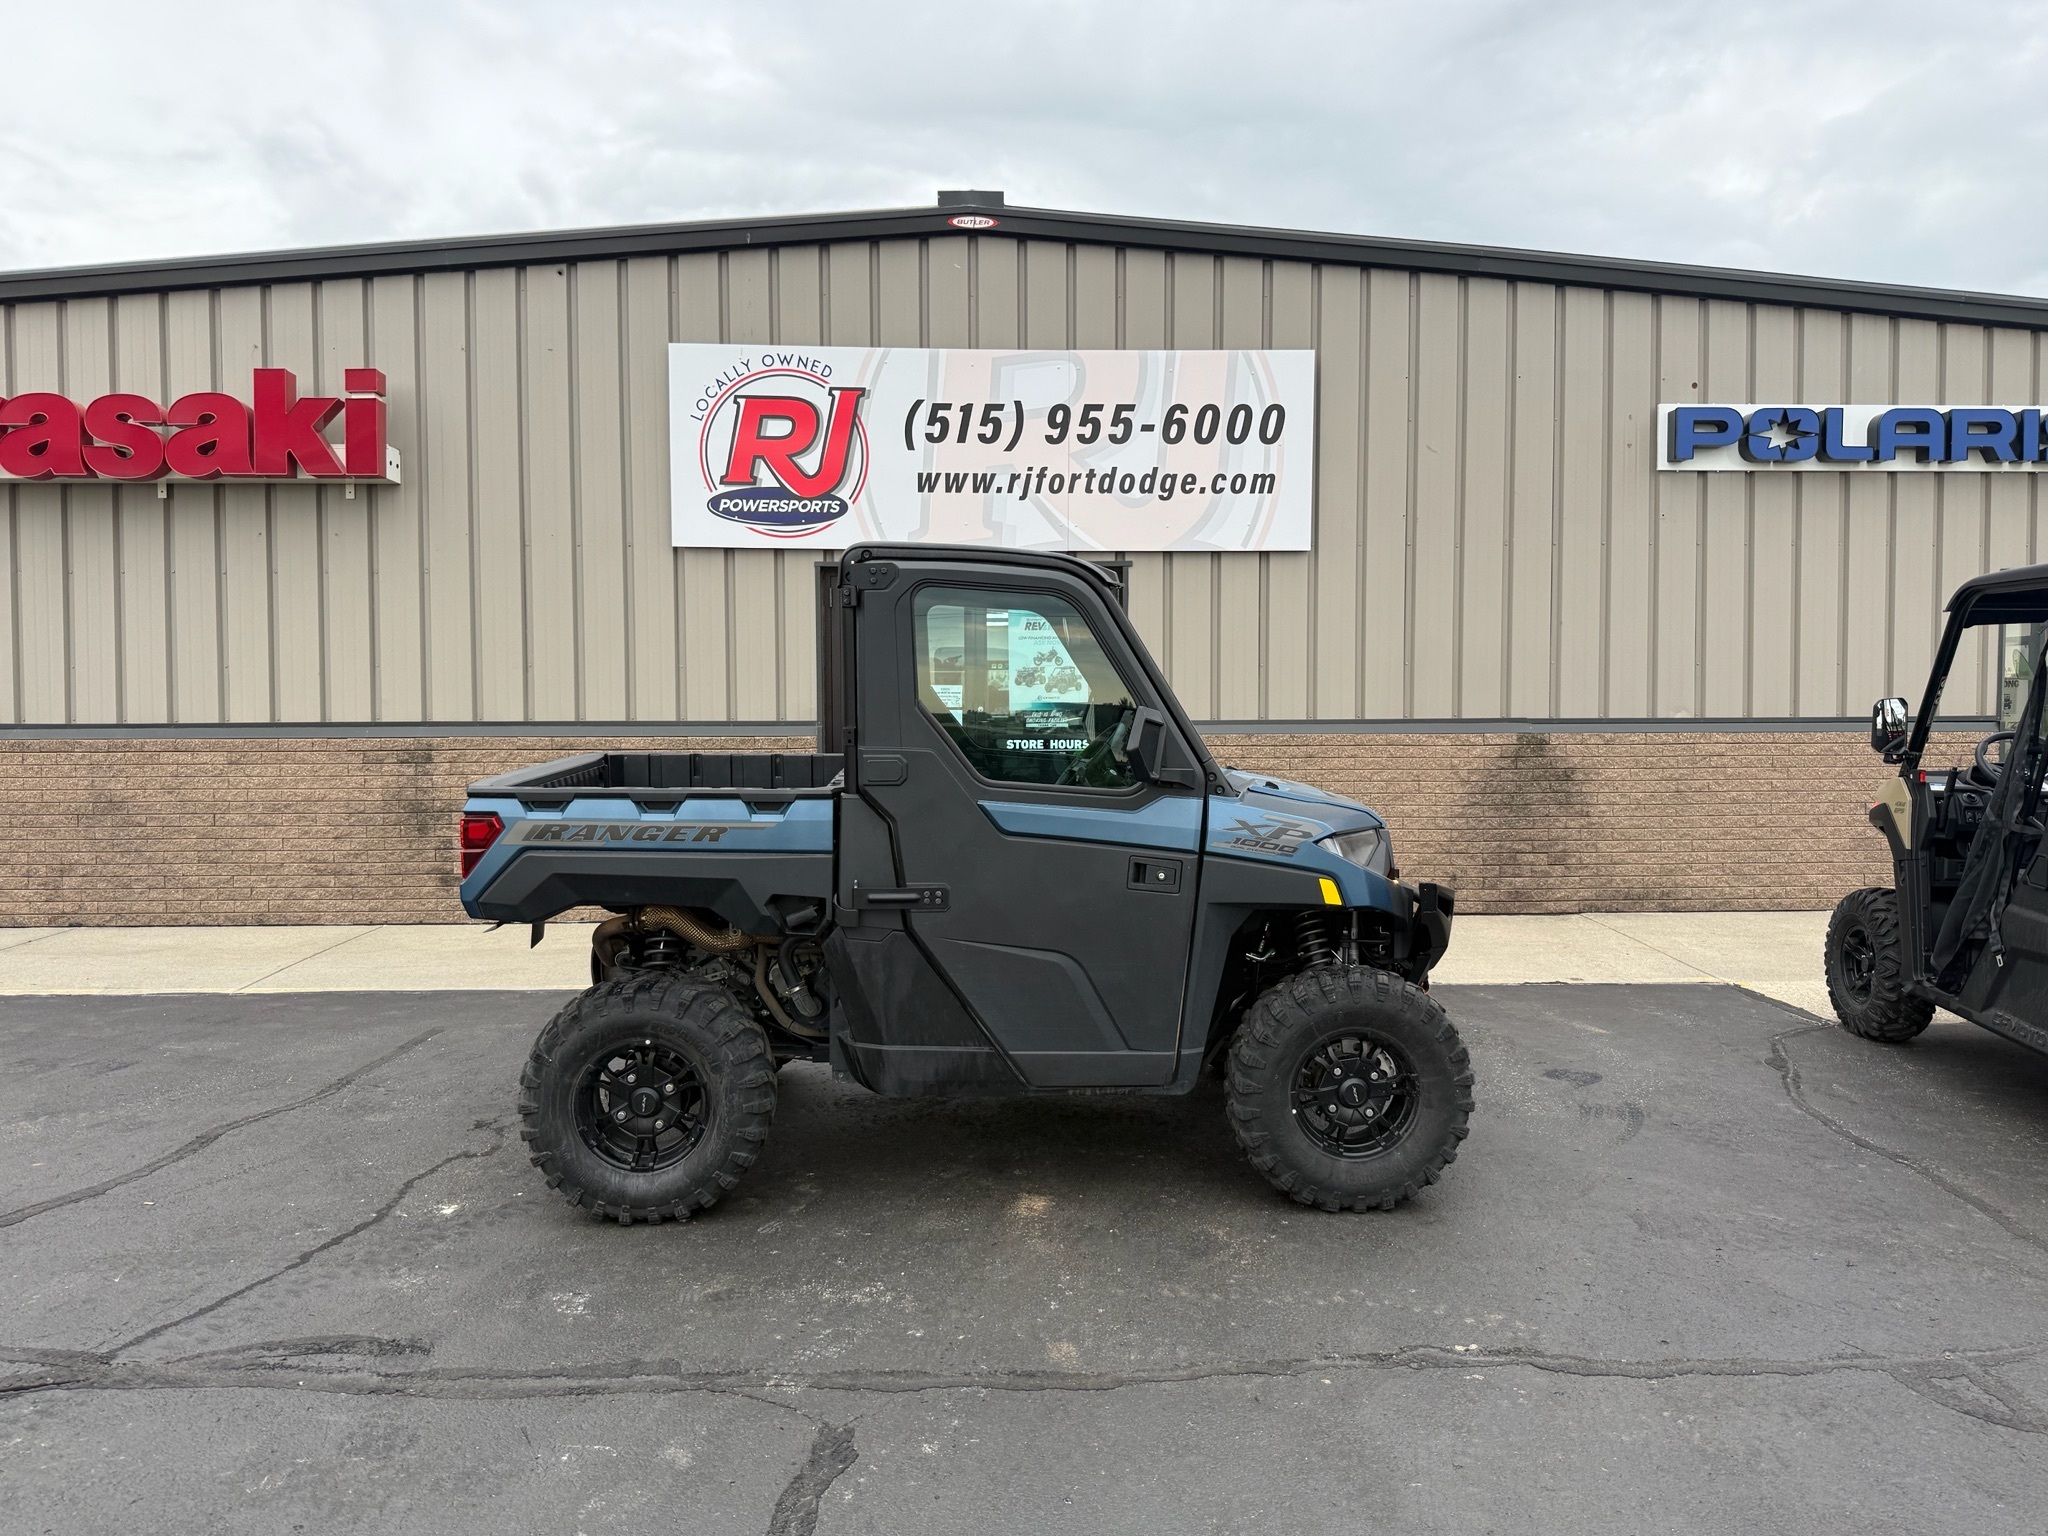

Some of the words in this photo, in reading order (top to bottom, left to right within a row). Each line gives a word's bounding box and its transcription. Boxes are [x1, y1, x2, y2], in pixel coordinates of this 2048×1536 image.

[690, 358, 752, 422] LOCALLY
[761, 353, 833, 378] OWNED
[0, 367, 387, 479] asaki
[904, 398, 1025, 452] (515)
[1044, 402, 1286, 446] 955-6000
[719, 386, 866, 499] RJ
[916, 465, 1277, 501] www.rjfortdodge.com
[719, 499, 841, 514] POWERSPORTS
[1006, 739, 1044, 750] STORE
[1050, 739, 1090, 750] HOURS
[530, 823, 730, 843] RANGER
[1218, 817, 1315, 841] XP
[1230, 837, 1299, 854] 1000
